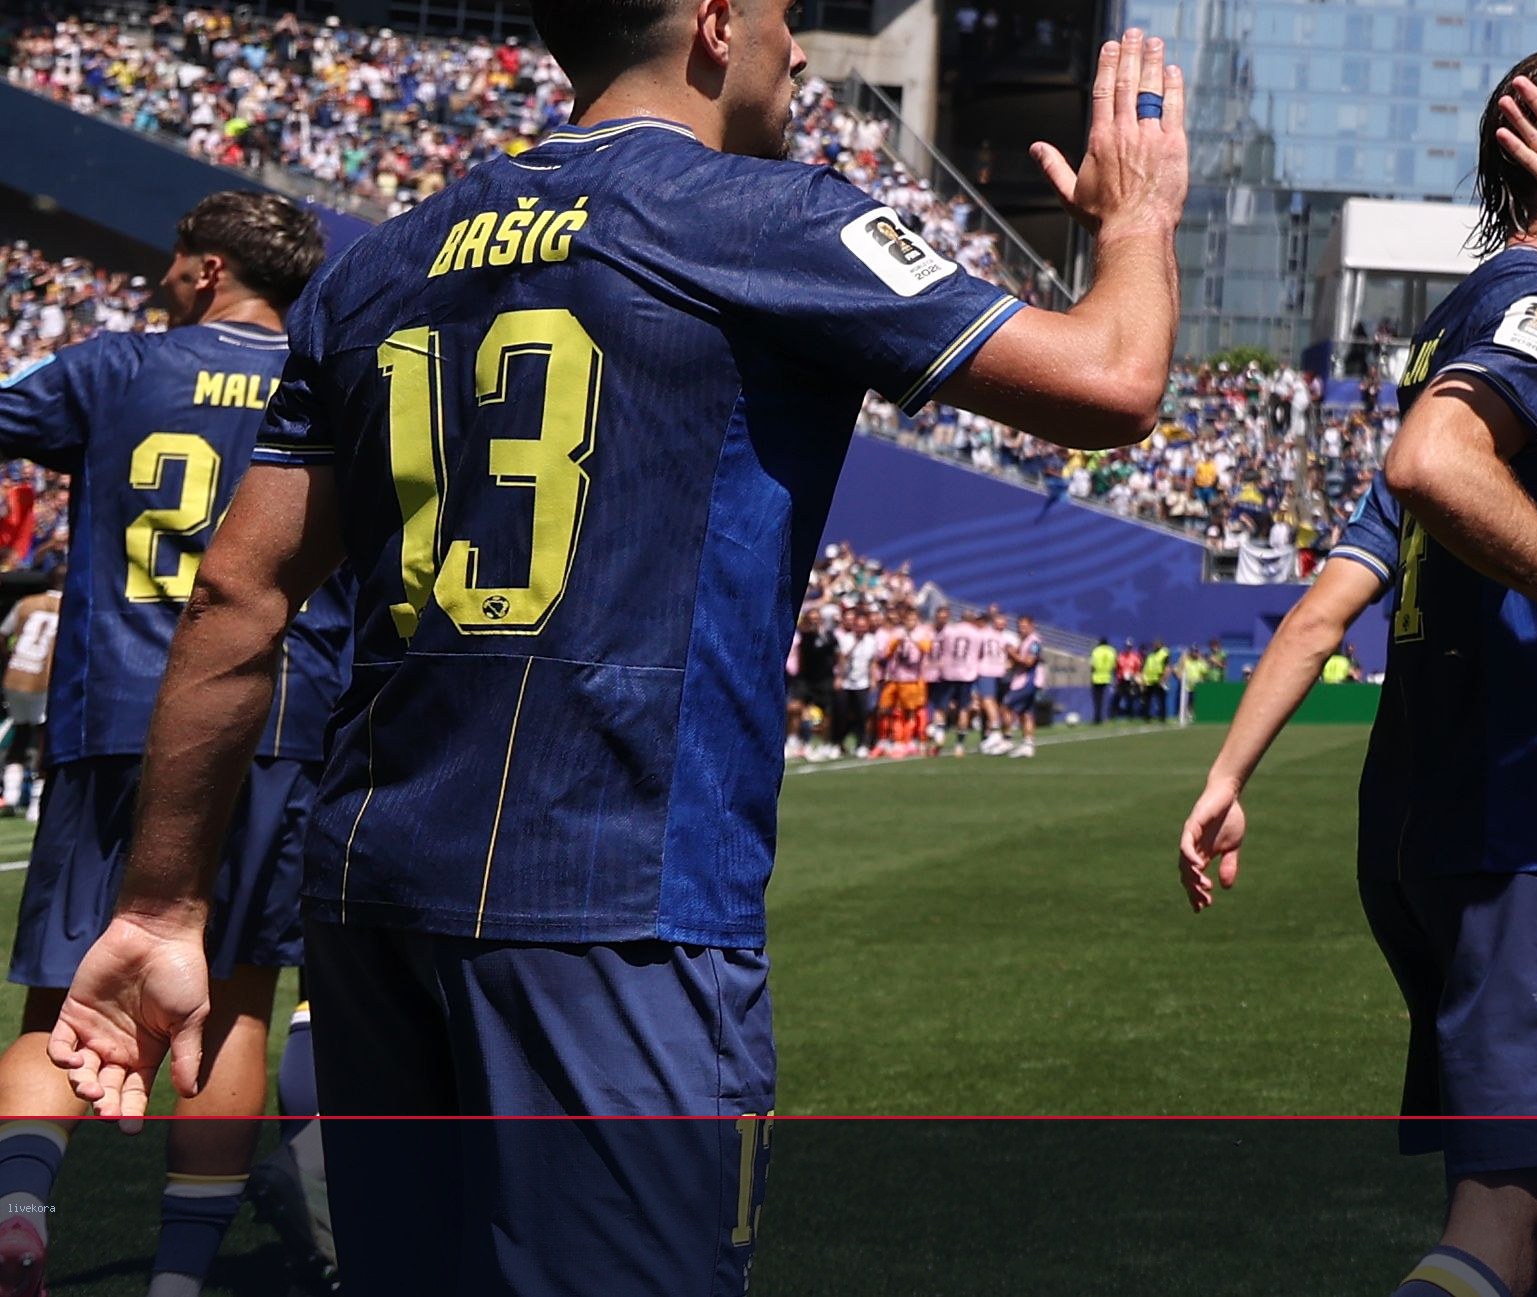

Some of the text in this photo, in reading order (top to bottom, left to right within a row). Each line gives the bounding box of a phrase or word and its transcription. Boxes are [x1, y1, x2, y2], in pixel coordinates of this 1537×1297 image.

[427, 196, 589, 278] BAŠIĆ
[193, 370, 281, 409] MAL
[125, 432, 228, 603] 2
[377, 308, 603, 640] 13
